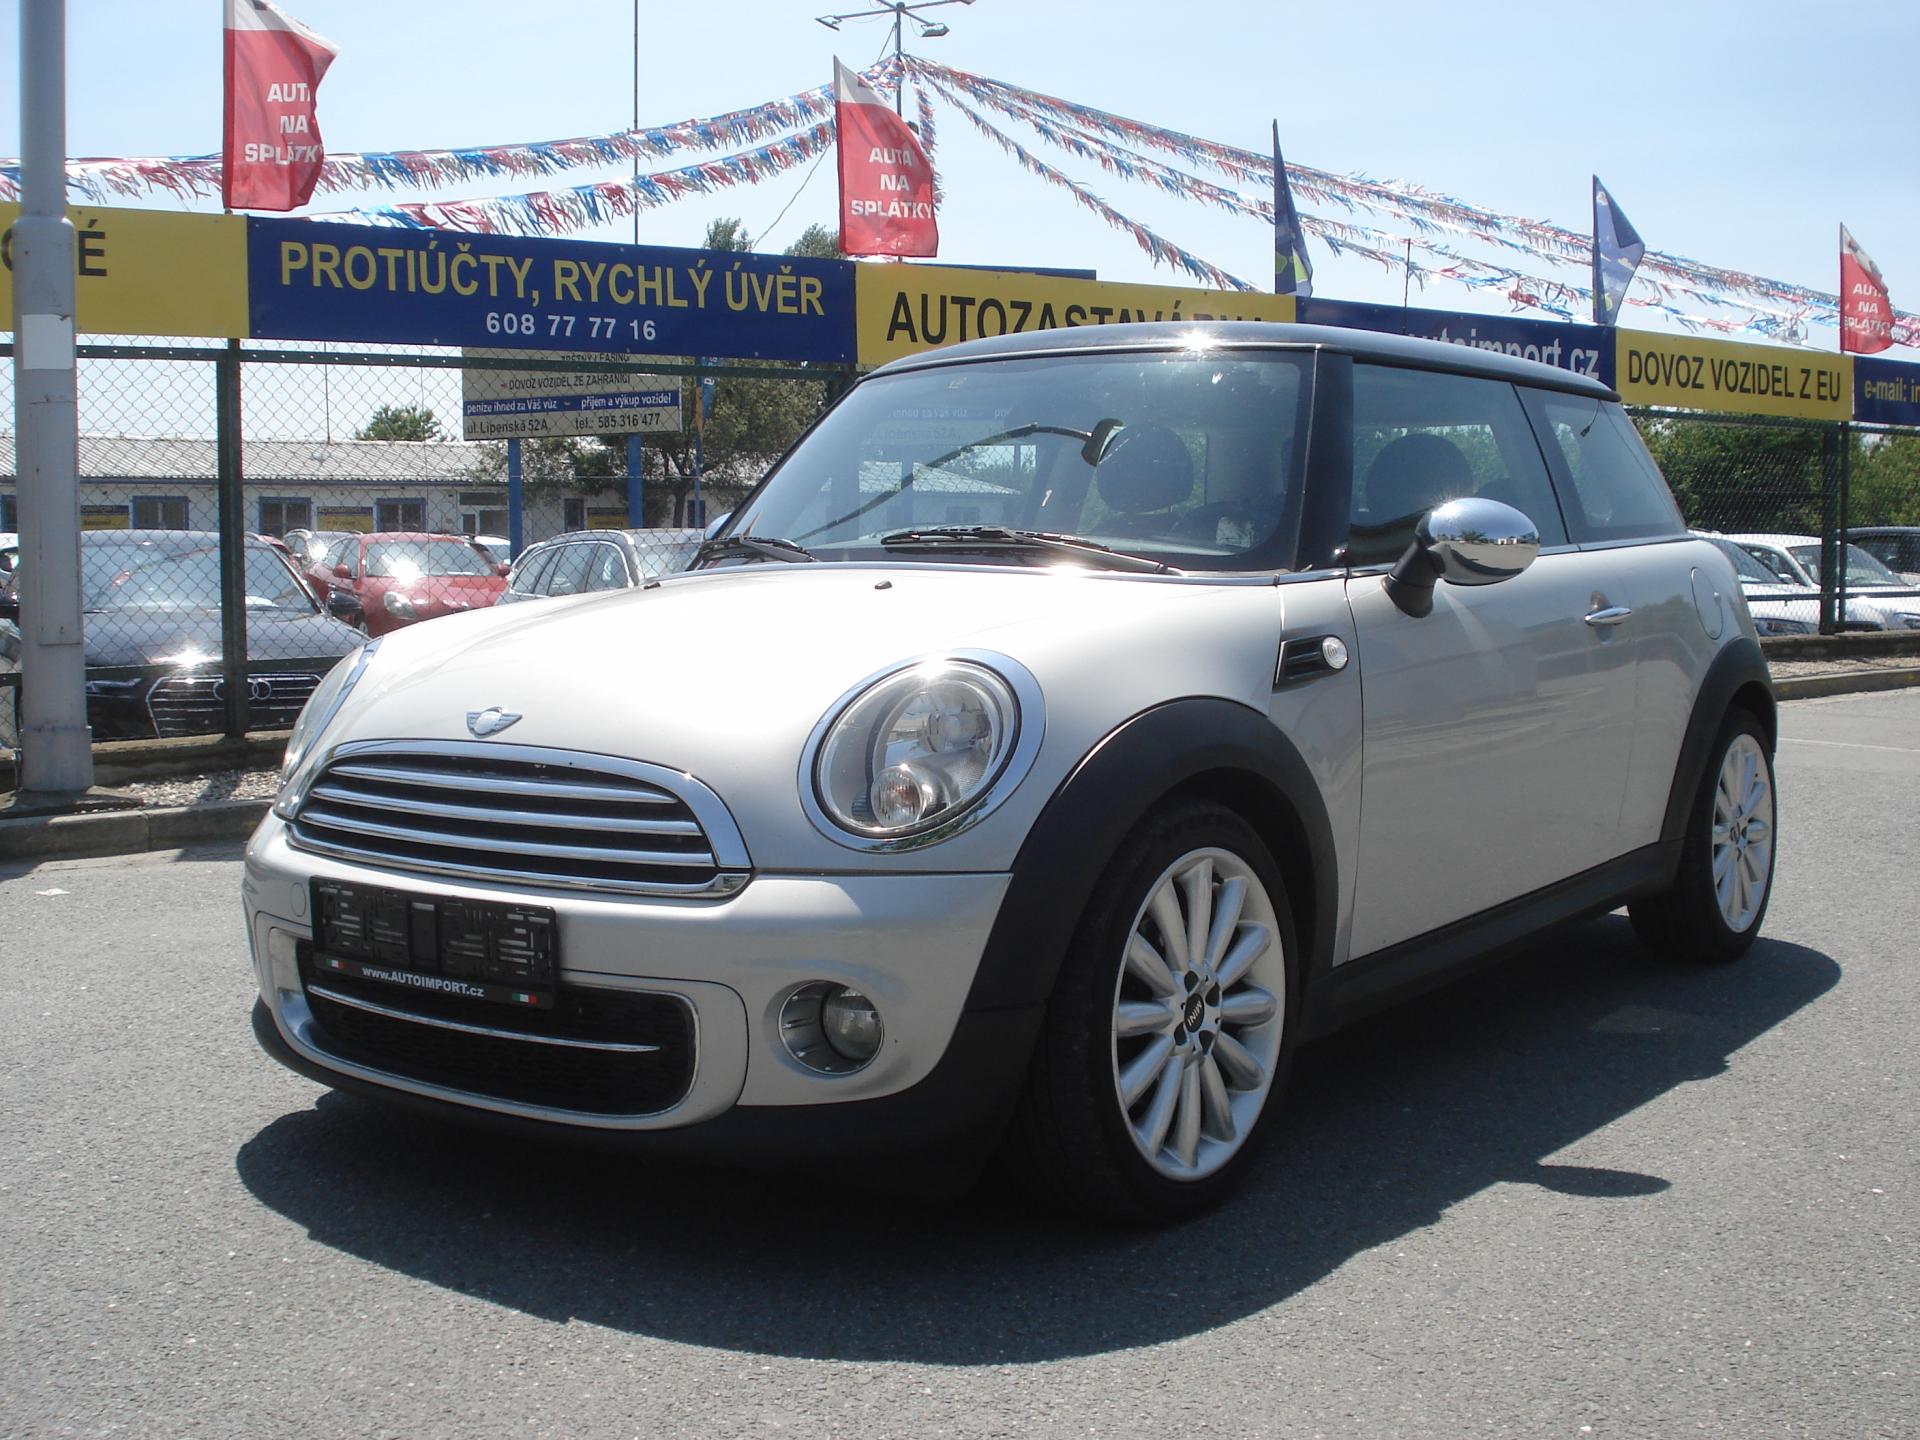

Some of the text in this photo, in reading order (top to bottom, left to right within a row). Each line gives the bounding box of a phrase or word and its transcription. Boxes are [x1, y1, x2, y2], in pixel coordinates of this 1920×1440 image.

[267, 83, 310, 102] AUT
[280, 115, 308, 133] NA
[869, 147, 913, 166] AUTA
[880, 174, 910, 191] NA
[851, 198, 933, 219] SPLÁTKY
[281, 240, 825, 316] PROTIÚČTY, RYCHLÝ ÚVĚR
[1853, 283, 1883, 297] AUT
[1858, 301, 1879, 313] NA
[486, 312, 656, 341] 608 77 77 16
[886, 291, 1263, 345] AUTOZAS
[509, 378, 536, 391] DOVOZ
[538, 376, 572, 389] VOZIDEL
[1628, 350, 1841, 402] DOVOZ VOZIDEL Z EU
[641, 392, 671, 405] vozidel
[1864, 377, 1907, 402] e-mail:
[620, 414, 638, 427] 316
[641, 413, 660, 426] 477
[362, 966, 485, 997] www.AUTOIMPORT.cz
